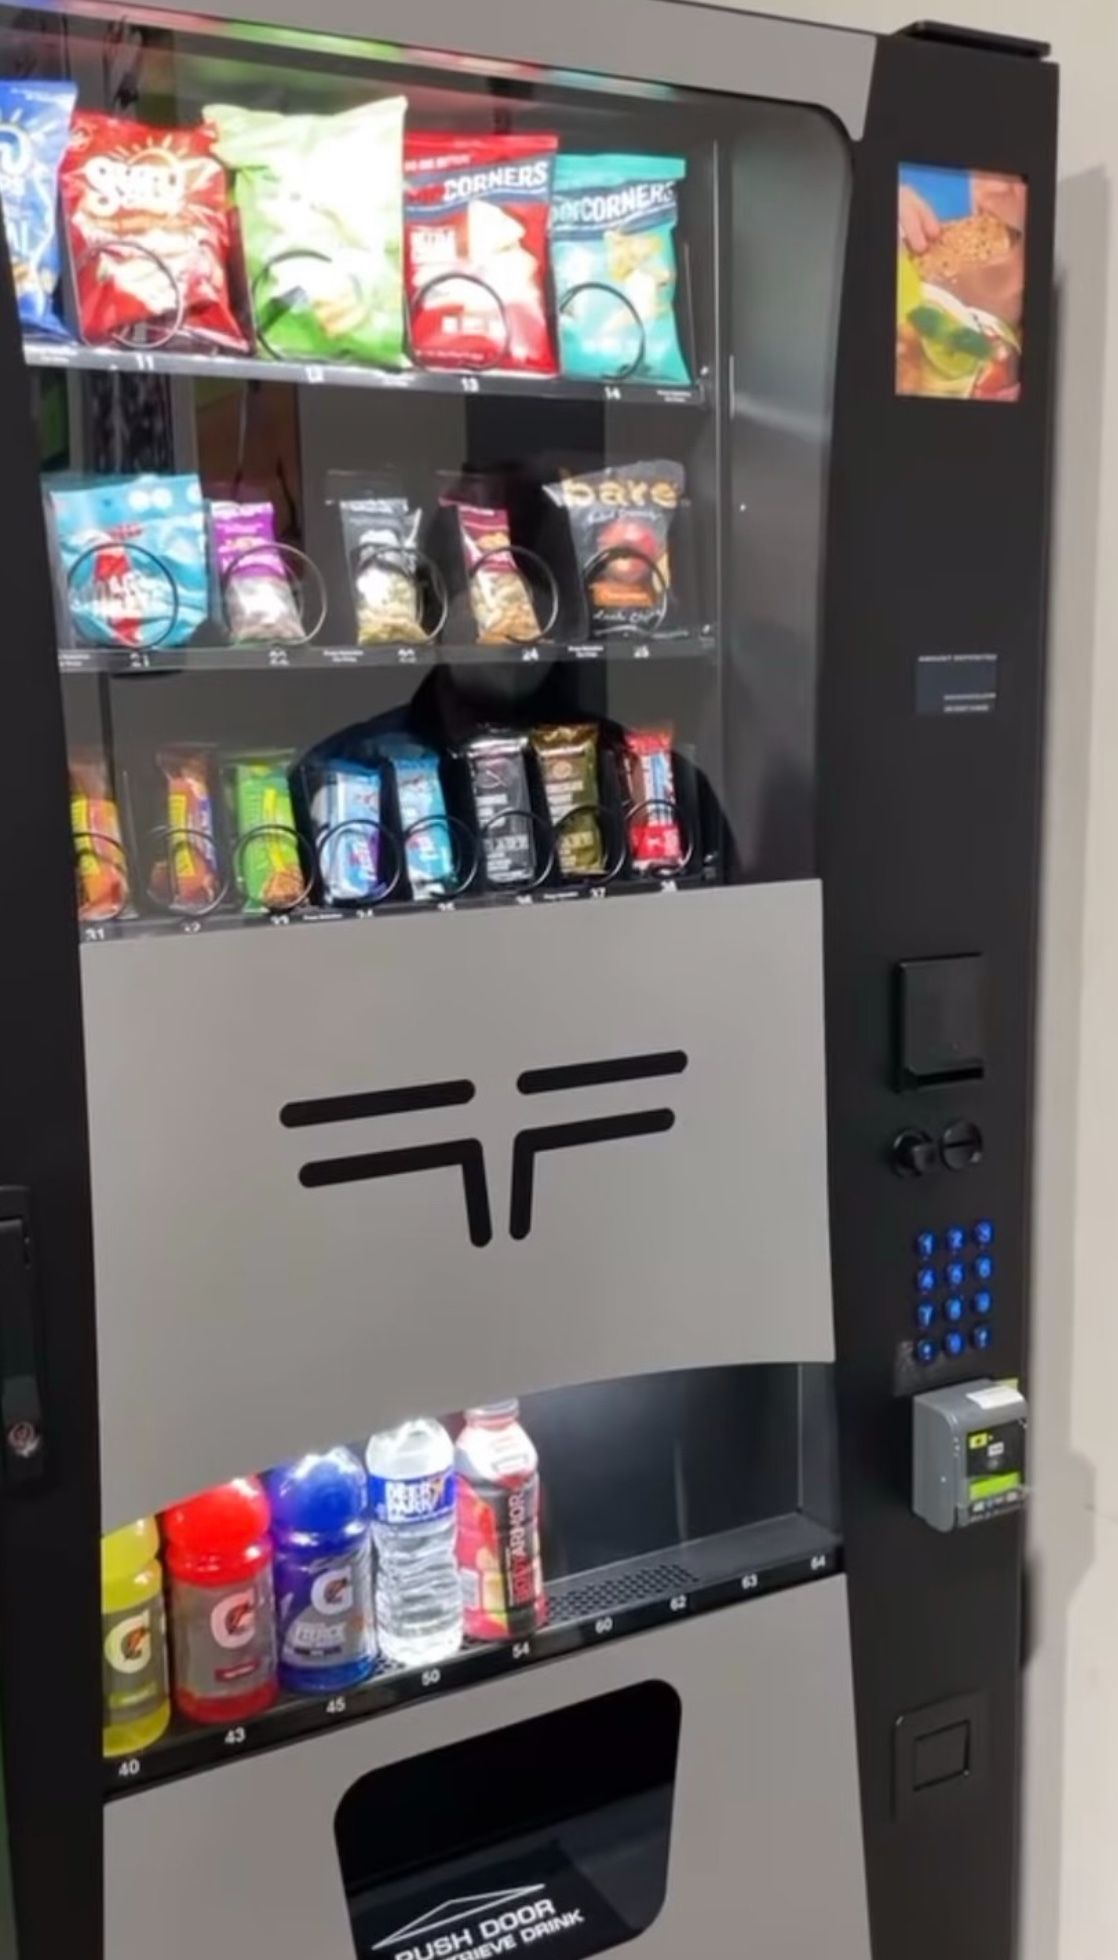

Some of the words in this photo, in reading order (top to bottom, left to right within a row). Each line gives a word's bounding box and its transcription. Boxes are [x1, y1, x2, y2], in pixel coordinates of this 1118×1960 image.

[135, 354, 154, 370] 11
[461, 377, 479, 392] 13
[604, 385, 621, 400] 14
[560, 468, 678, 509] bare
[522, 647, 540, 661] 24
[811, 1555, 827, 1570] 64
[311, 1565, 354, 1615] G
[742, 1573, 758, 1590] 63
[670, 1595, 687, 1611] 62
[211, 1587, 256, 1649] G
[595, 1617, 613, 1634] 60
[104, 1608, 152, 1674] G
[512, 1642, 530, 1658] 54
[421, 1669, 441, 1686] 50
[326, 1697, 346, 1713] 45
[224, 1727, 246, 1744] 43
[118, 1759, 140, 1776] 40
[479, 1899, 556, 1939] DOOR
[520, 1908, 585, 1943] DRINK
